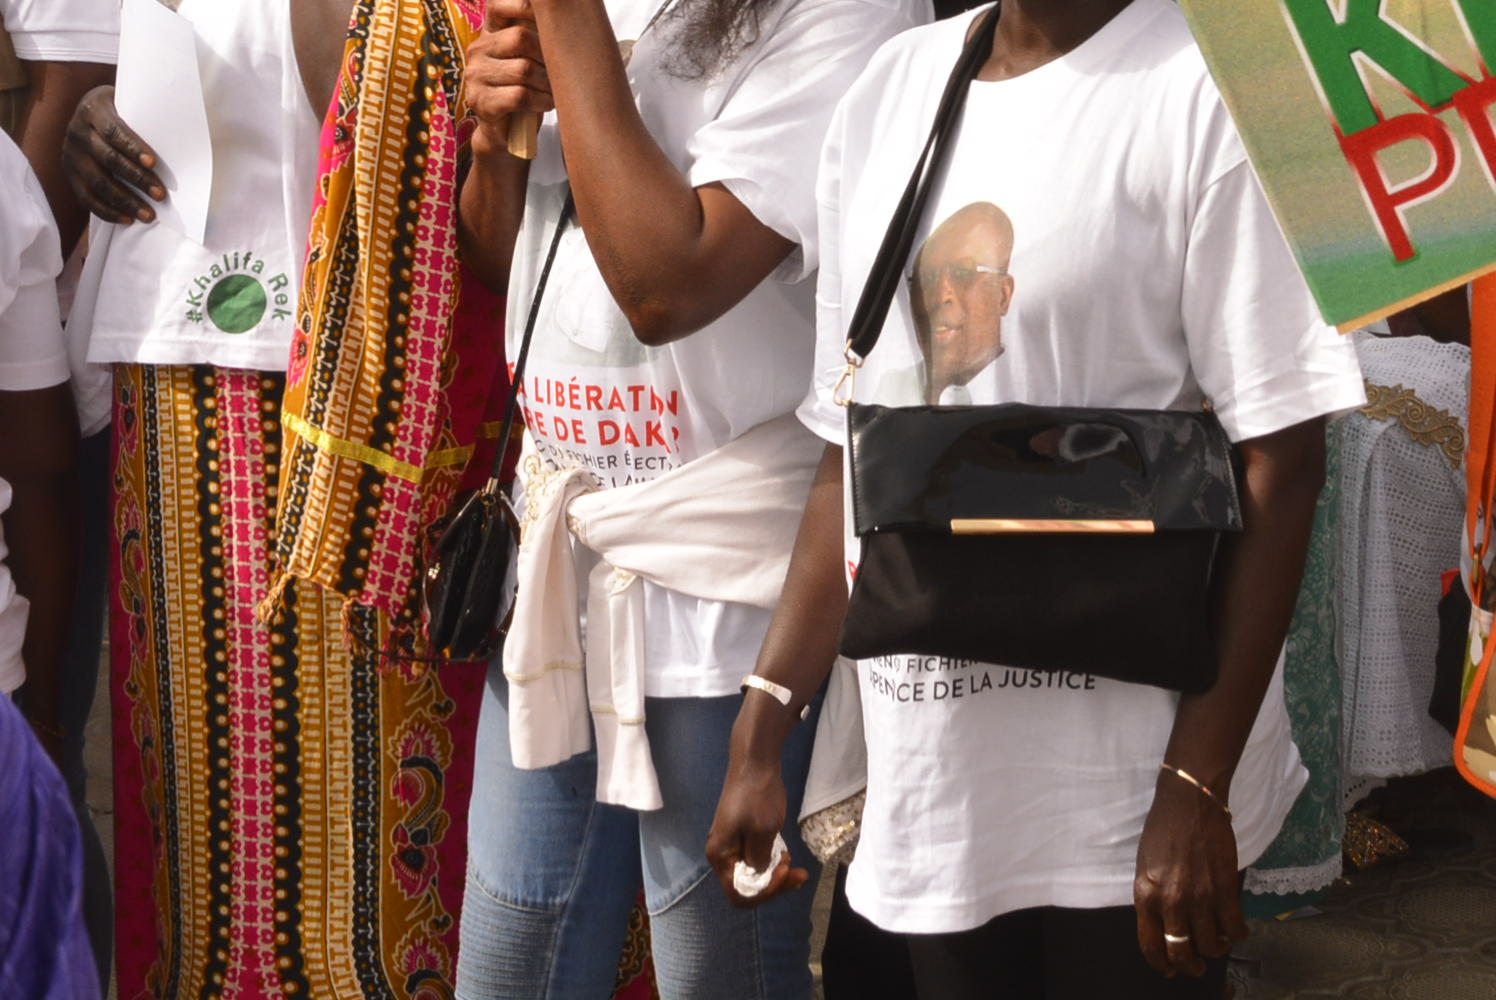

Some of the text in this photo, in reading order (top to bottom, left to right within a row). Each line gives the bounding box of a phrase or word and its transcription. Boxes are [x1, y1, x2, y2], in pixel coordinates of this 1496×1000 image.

[185, 251, 292, 324] #Khalifa Rek
[553, 416, 587, 445] DE
[933, 678, 964, 700] DE
[970, 671, 992, 694] LA
[998, 669, 1097, 691] JUSTICE
